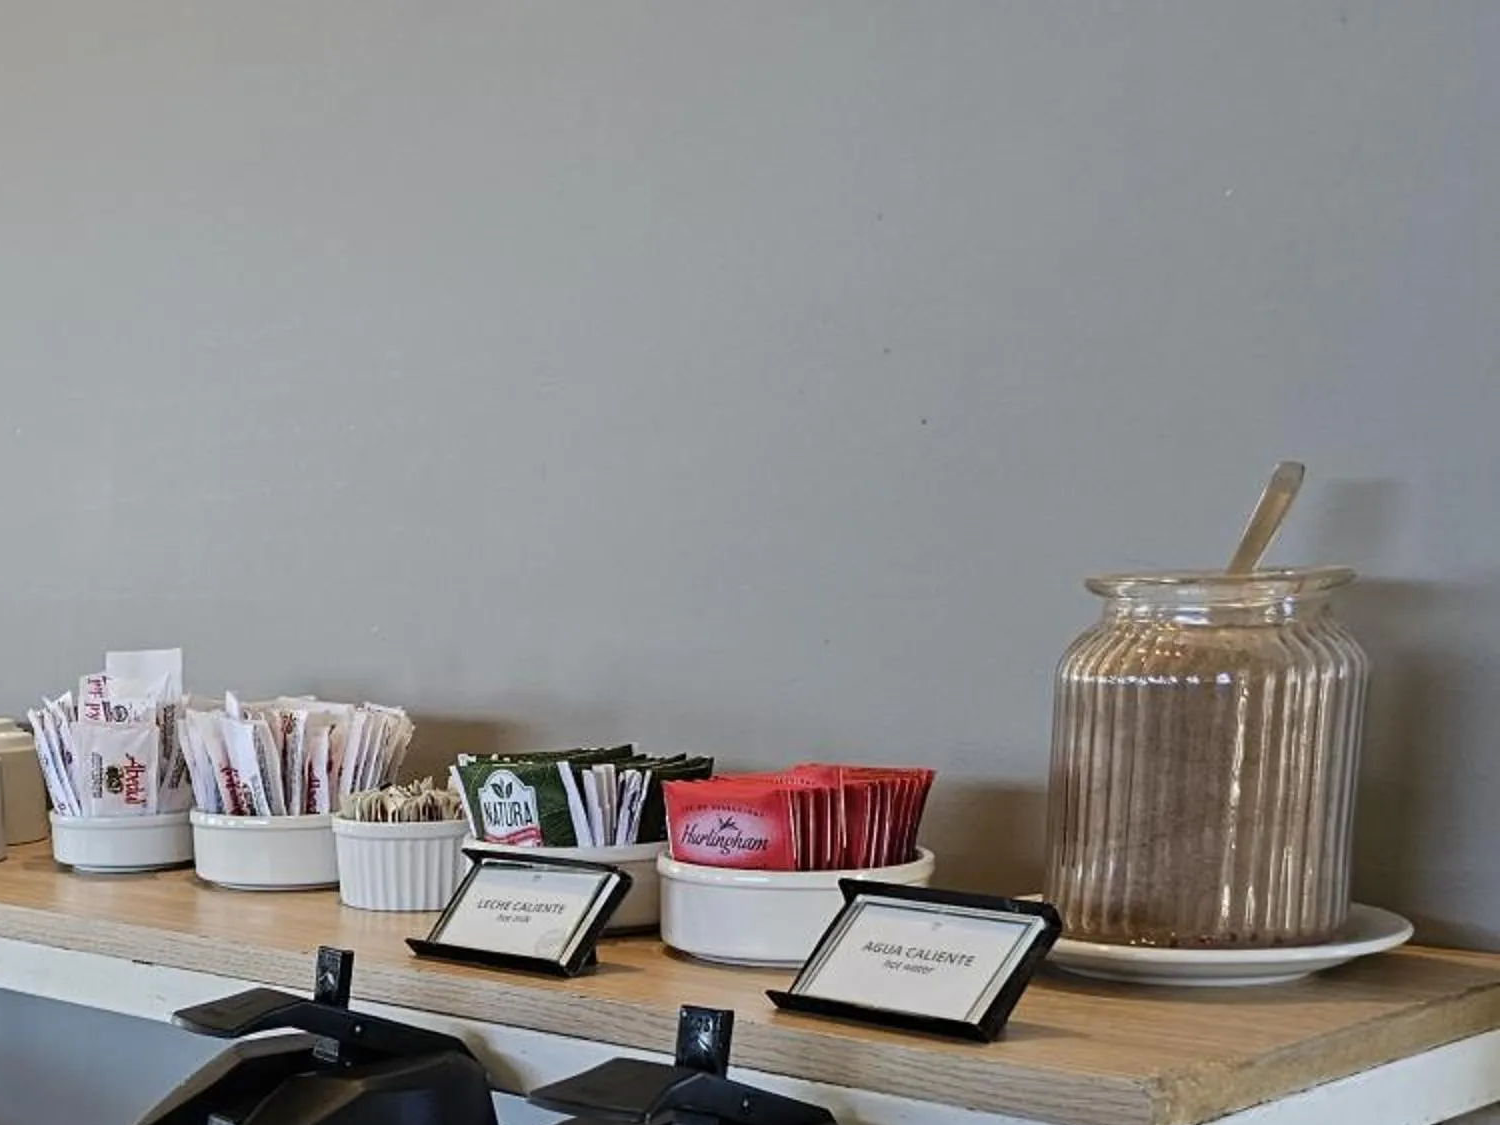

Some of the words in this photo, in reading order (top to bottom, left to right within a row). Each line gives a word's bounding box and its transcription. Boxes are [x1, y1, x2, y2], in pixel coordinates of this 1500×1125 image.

[483, 801, 533, 826] NATURA
[681, 823, 769, 856] Hurlingham
[477, 899, 512, 911] LECHE
[512, 900, 566, 915] CALIENTE
[862, 941, 903, 956] AGUA
[905, 947, 976, 967] CALIENTE
